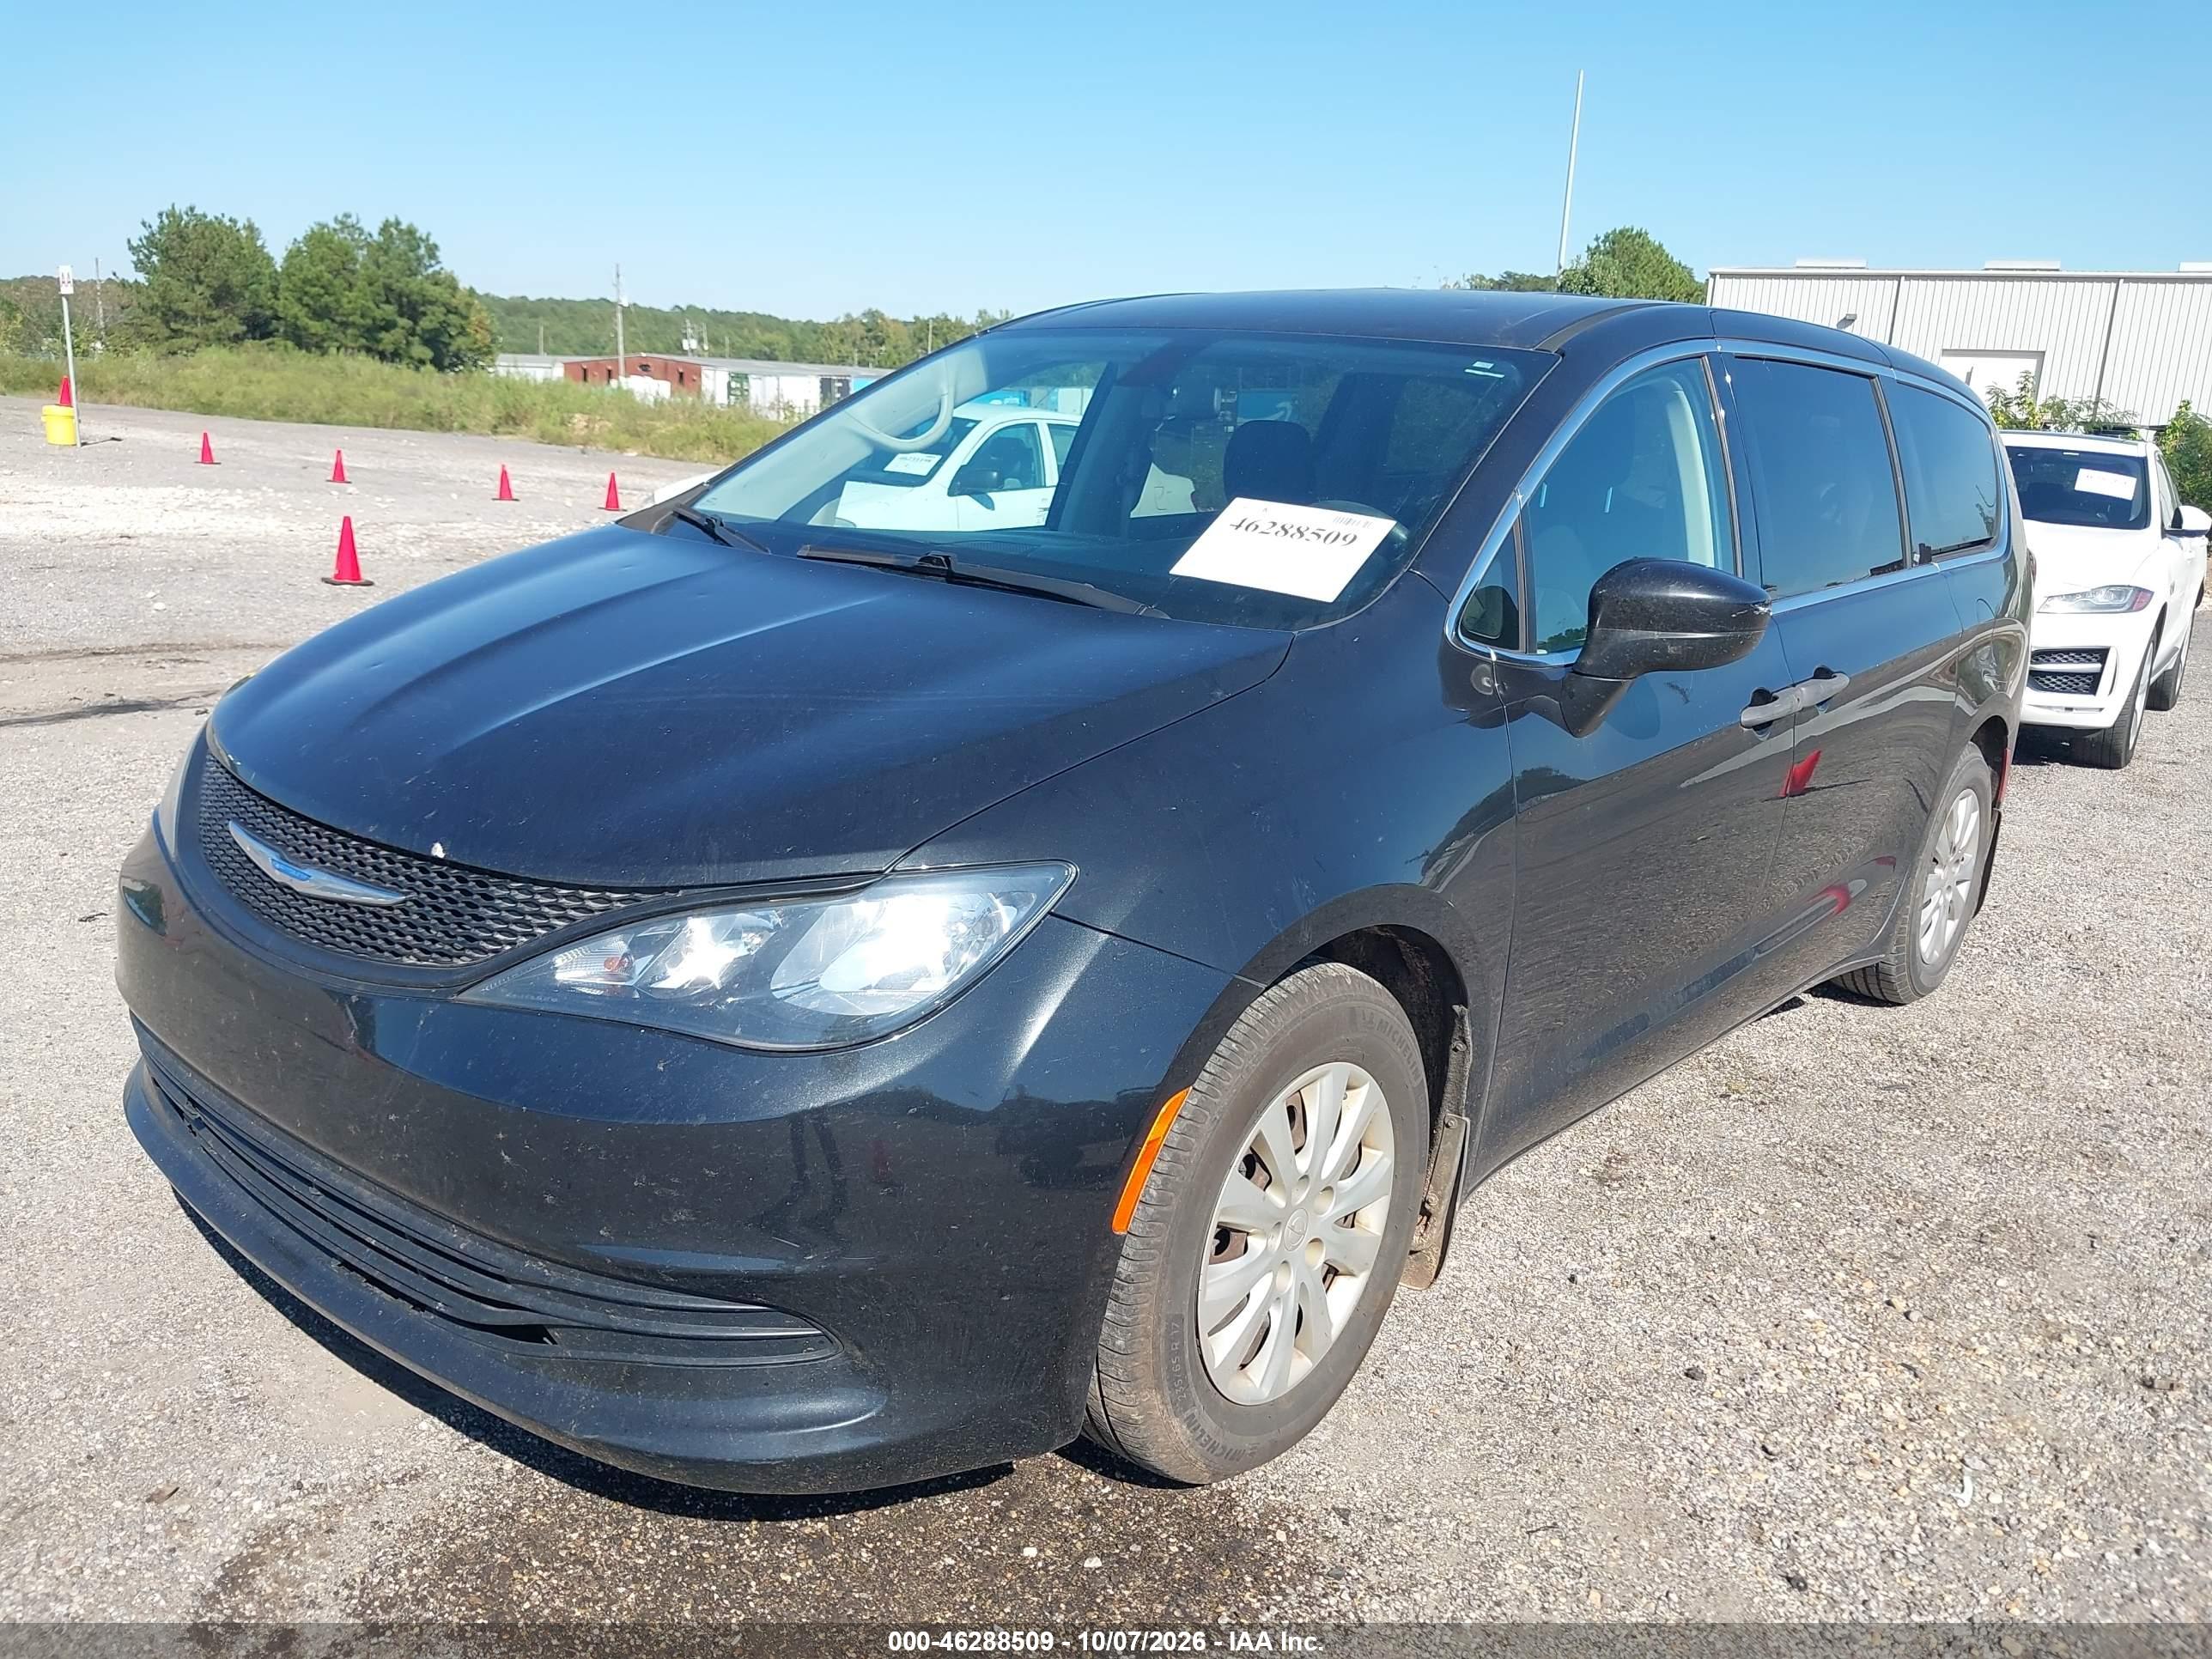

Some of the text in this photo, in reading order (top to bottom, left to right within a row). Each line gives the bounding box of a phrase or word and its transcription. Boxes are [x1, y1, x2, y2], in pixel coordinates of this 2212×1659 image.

[1230, 518, 1358, 546] 46288509
[1376, 1018, 1422, 1081] MICHELIN
[1171, 1322, 1182, 1338] 17
[1170, 1341, 1181, 1352] R
[1184, 1413, 1246, 1461] MICHELIN
